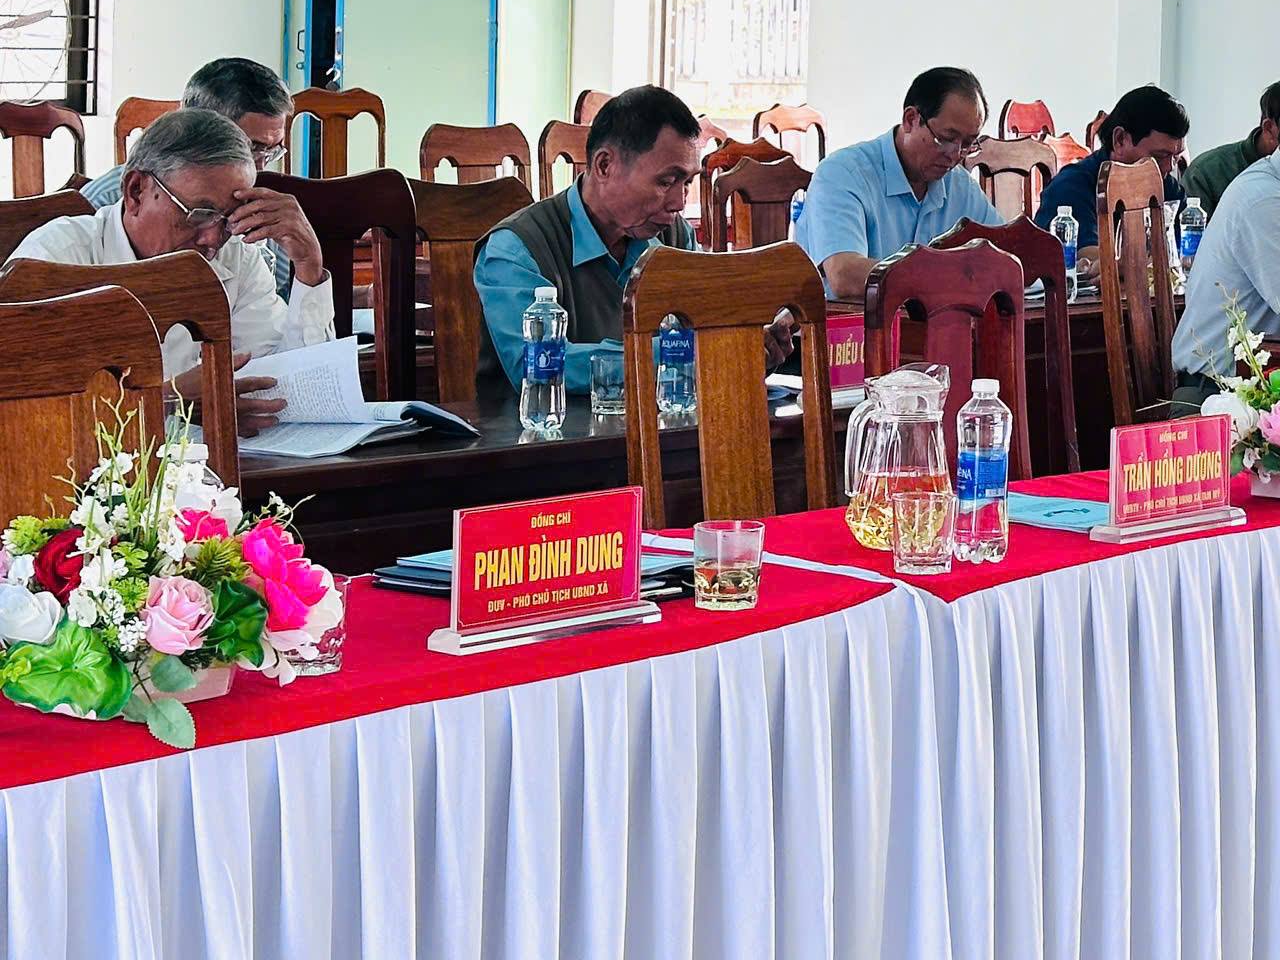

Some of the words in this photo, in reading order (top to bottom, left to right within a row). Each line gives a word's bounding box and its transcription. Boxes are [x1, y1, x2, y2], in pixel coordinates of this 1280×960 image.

[835, 333, 859, 366] BIỂU
[1186, 449, 1222, 483] DƯƠNG
[556, 510, 571, 525] CHÍ
[474, 545, 525, 591] PHAN
[529, 534, 572, 582] ĐÌNH
[576, 531, 623, 575] DUNG
[512, 593, 531, 609] PHÓ
[532, 588, 550, 606] CHỦ
[552, 589, 570, 604] TỊCH
[572, 584, 595, 599] UBND
